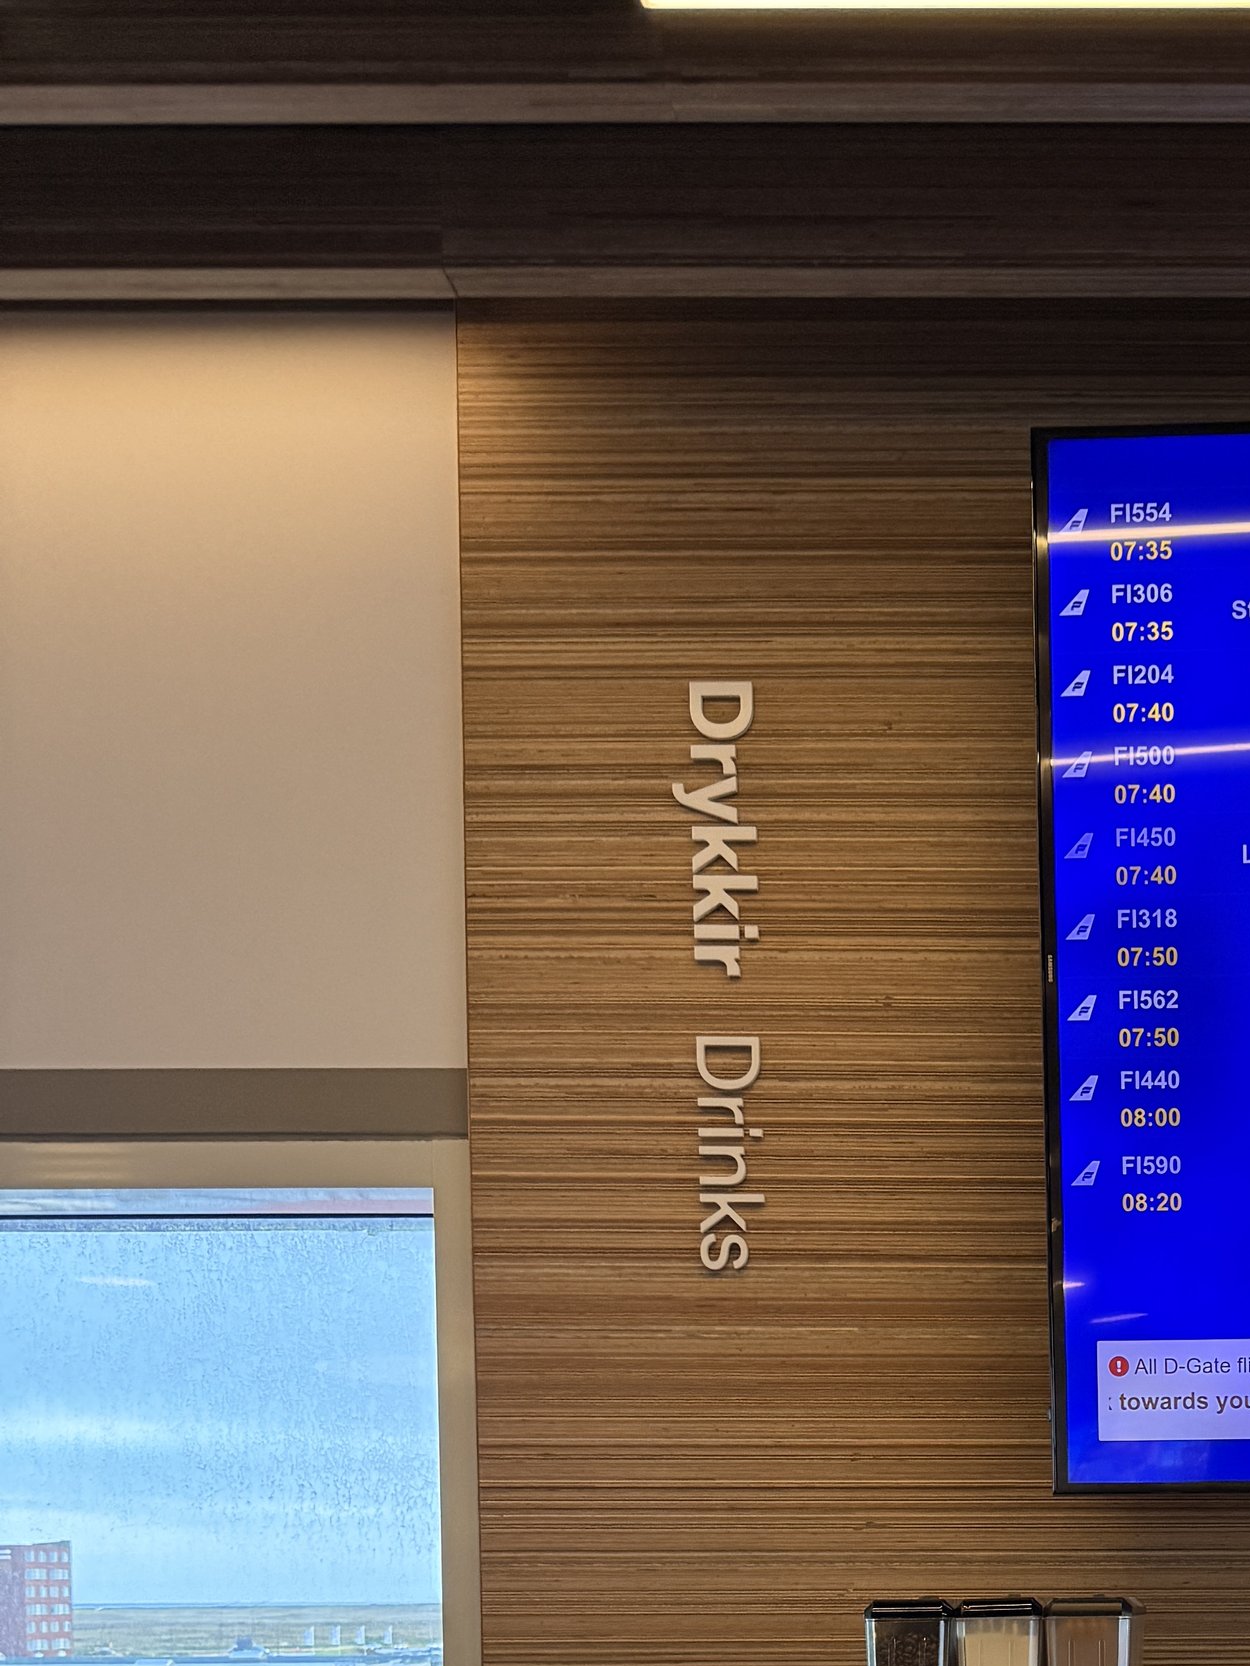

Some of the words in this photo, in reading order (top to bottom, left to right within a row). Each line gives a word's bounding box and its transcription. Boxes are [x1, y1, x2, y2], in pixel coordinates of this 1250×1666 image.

[1110, 502, 1172, 525] FI554
[1109, 540, 1173, 562] 07:35
[1111, 582, 1173, 604] FI306
[1111, 620, 1174, 642] 07:35
[1112, 663, 1175, 685] FI204
[1112, 701, 1175, 724] 07:40
[1113, 744, 1176, 767] FI500
[1114, 783, 1176, 804] 07:40
[671, 680, 759, 980] Drykkir
[1116, 827, 1176, 847] FI450
[1115, 865, 1177, 886] 07:40
[1117, 908, 1178, 929] FI318
[1117, 946, 1178, 967] 07:50
[1118, 989, 1179, 1010] FI562
[1118, 1027, 1180, 1048] 07:50
[1120, 1069, 1180, 1090] FI440
[1120, 1107, 1181, 1128] 08:00
[696, 1036, 766, 1272] Drinks
[1122, 1155, 1181, 1175] FI590
[1122, 1192, 1183, 1212] 08:20
[1134, 1357, 1157, 1375] All
[1164, 1357, 1231, 1375] D-Gate
[1119, 1391, 1208, 1411] towards
